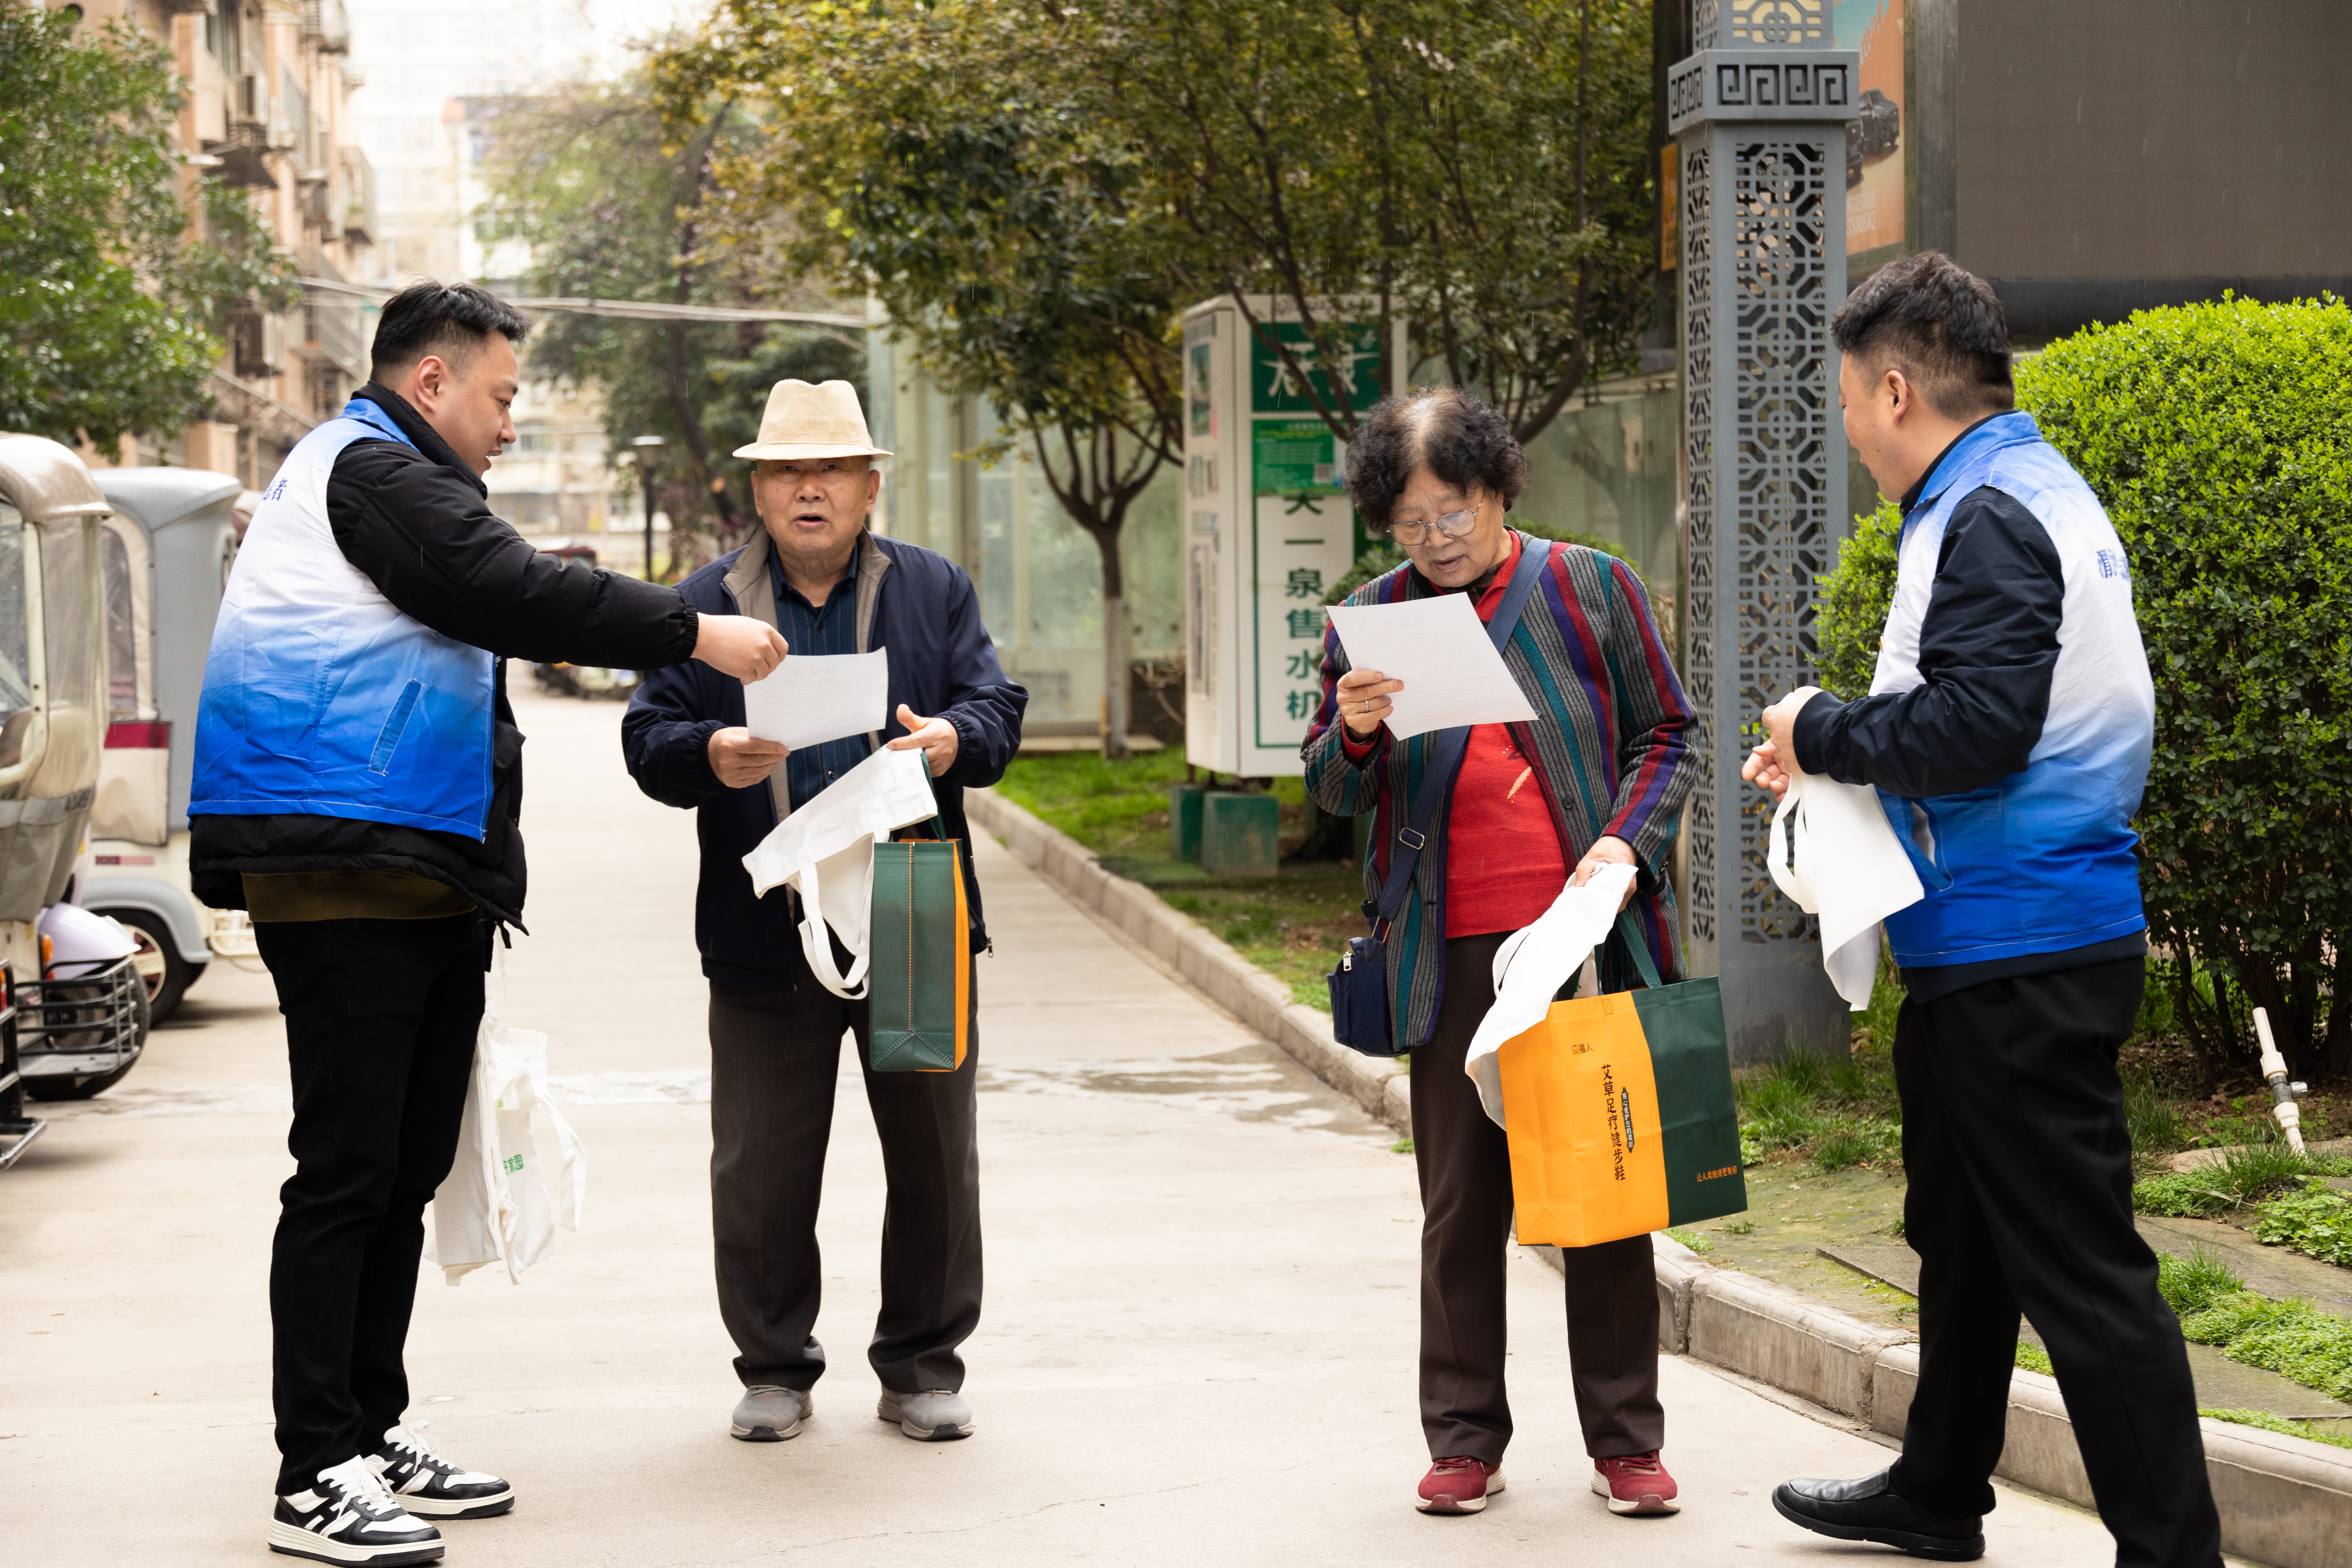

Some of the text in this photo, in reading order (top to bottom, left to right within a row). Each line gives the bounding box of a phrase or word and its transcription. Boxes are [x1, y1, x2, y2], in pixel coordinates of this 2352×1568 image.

[1602, 1064, 1626, 1181] 艾草足疗健步鞋
[1697, 1165, 1737, 1183] 让人类健康更美好
